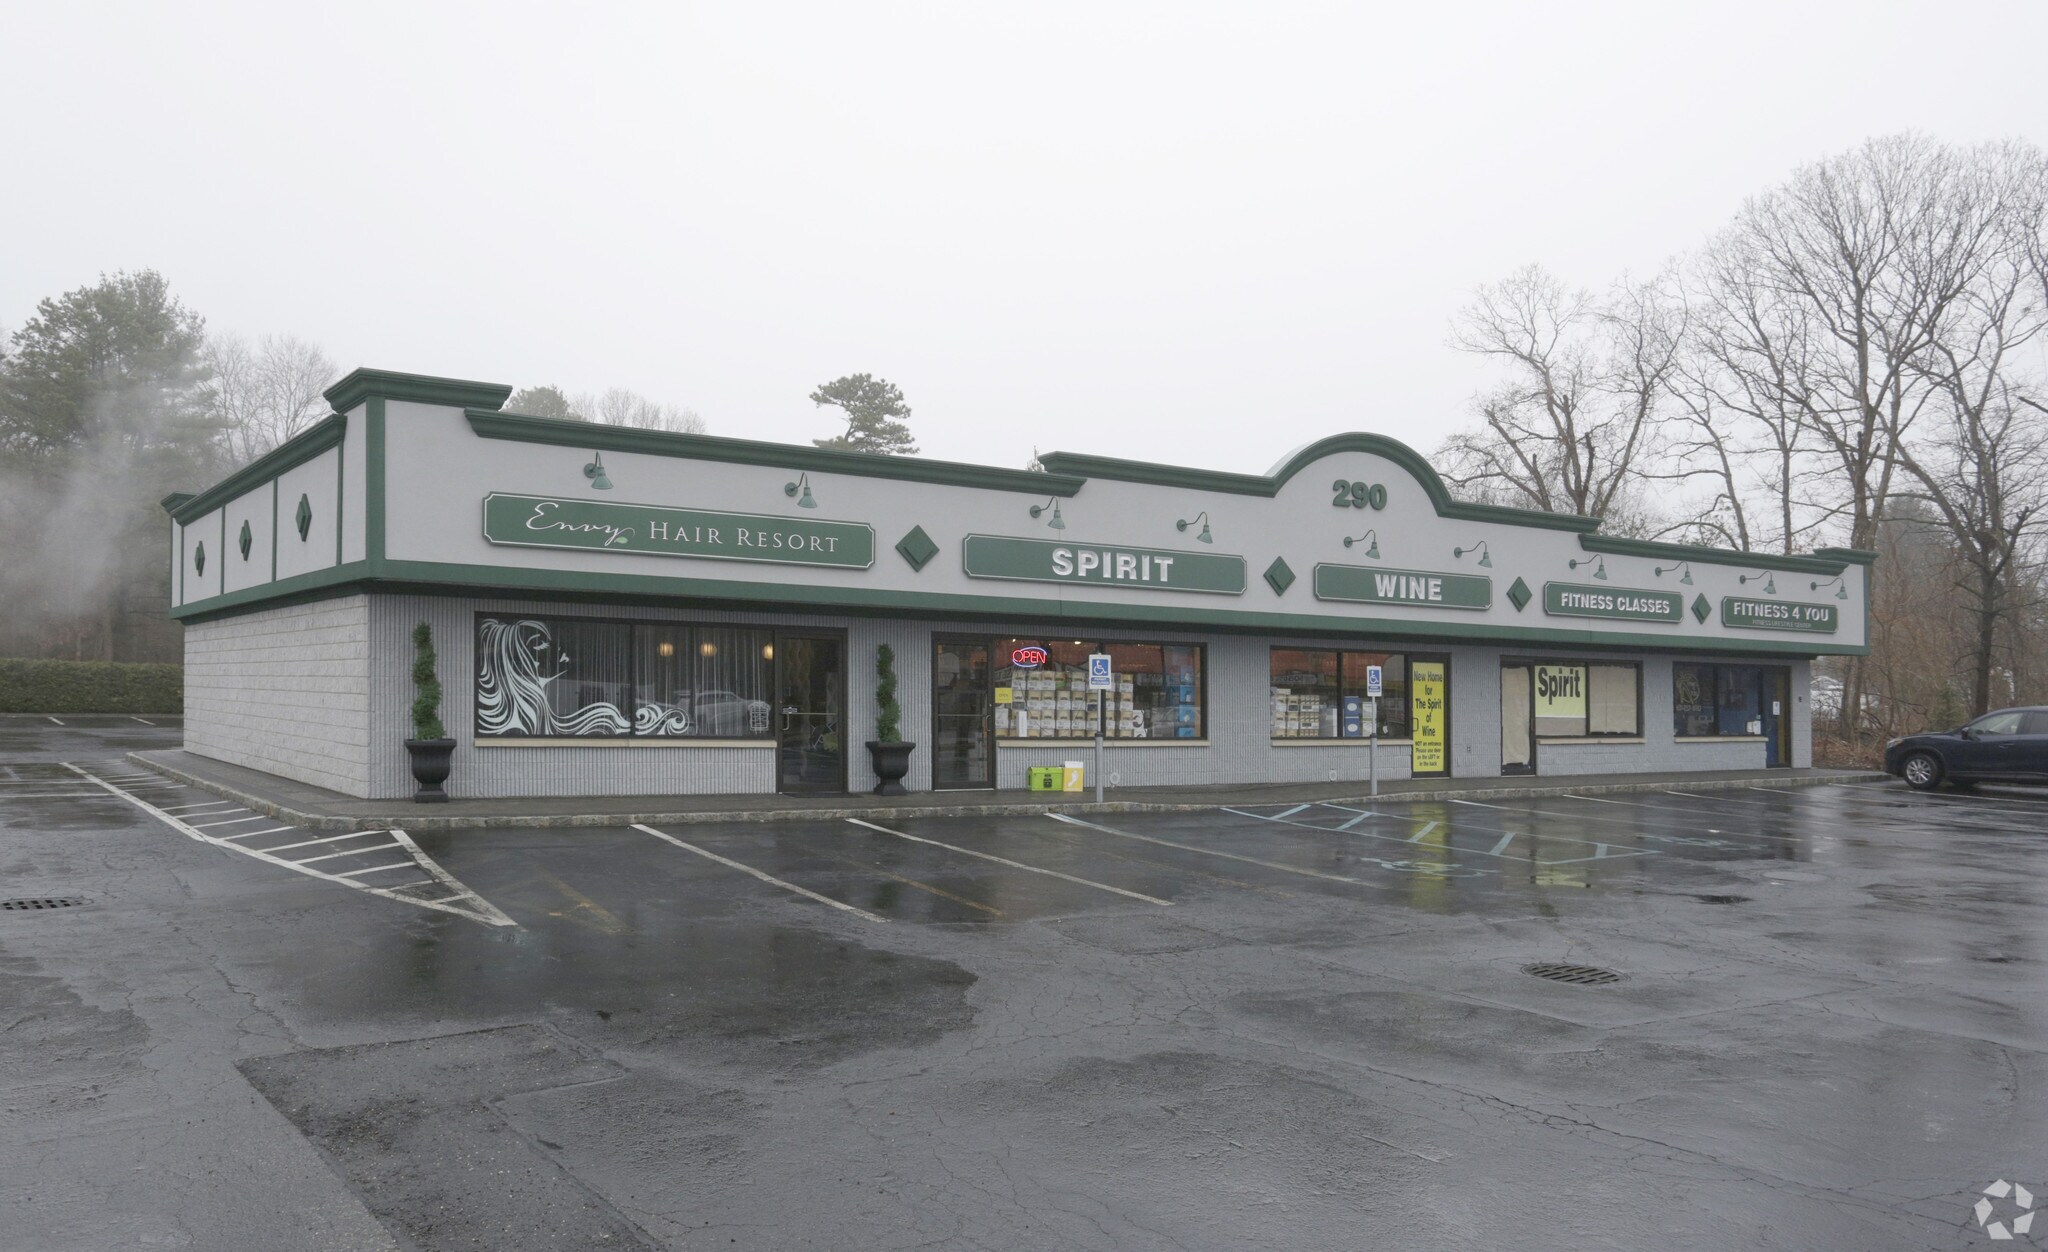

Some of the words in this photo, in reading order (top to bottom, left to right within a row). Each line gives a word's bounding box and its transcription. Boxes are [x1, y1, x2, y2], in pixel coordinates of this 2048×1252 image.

[1332, 479, 1388, 511] 290
[526, 501, 635, 547] Envy
[1051, 547, 1174, 582] SPIRIT
[1374, 573, 1442, 601] WINE
[1561, 592, 1614, 610] FITNESS
[1617, 597, 1670, 614] CLASSES
[1733, 602, 1788, 619] FITNESS
[1792, 606, 1800, 620] 4
[1804, 607, 1829, 622] YOU
[1012, 649, 1046, 664] OPEN
[1413, 670, 1426, 681] New
[1427, 671, 1443, 682] Home
[1538, 667, 1581, 705] Spirit
[1424, 684, 1433, 695] for
[1415, 698, 1426, 709] The
[1427, 698, 1442, 712] Spirit
[1426, 711, 1432, 723] of
[1422, 725, 1436, 736] Wine
